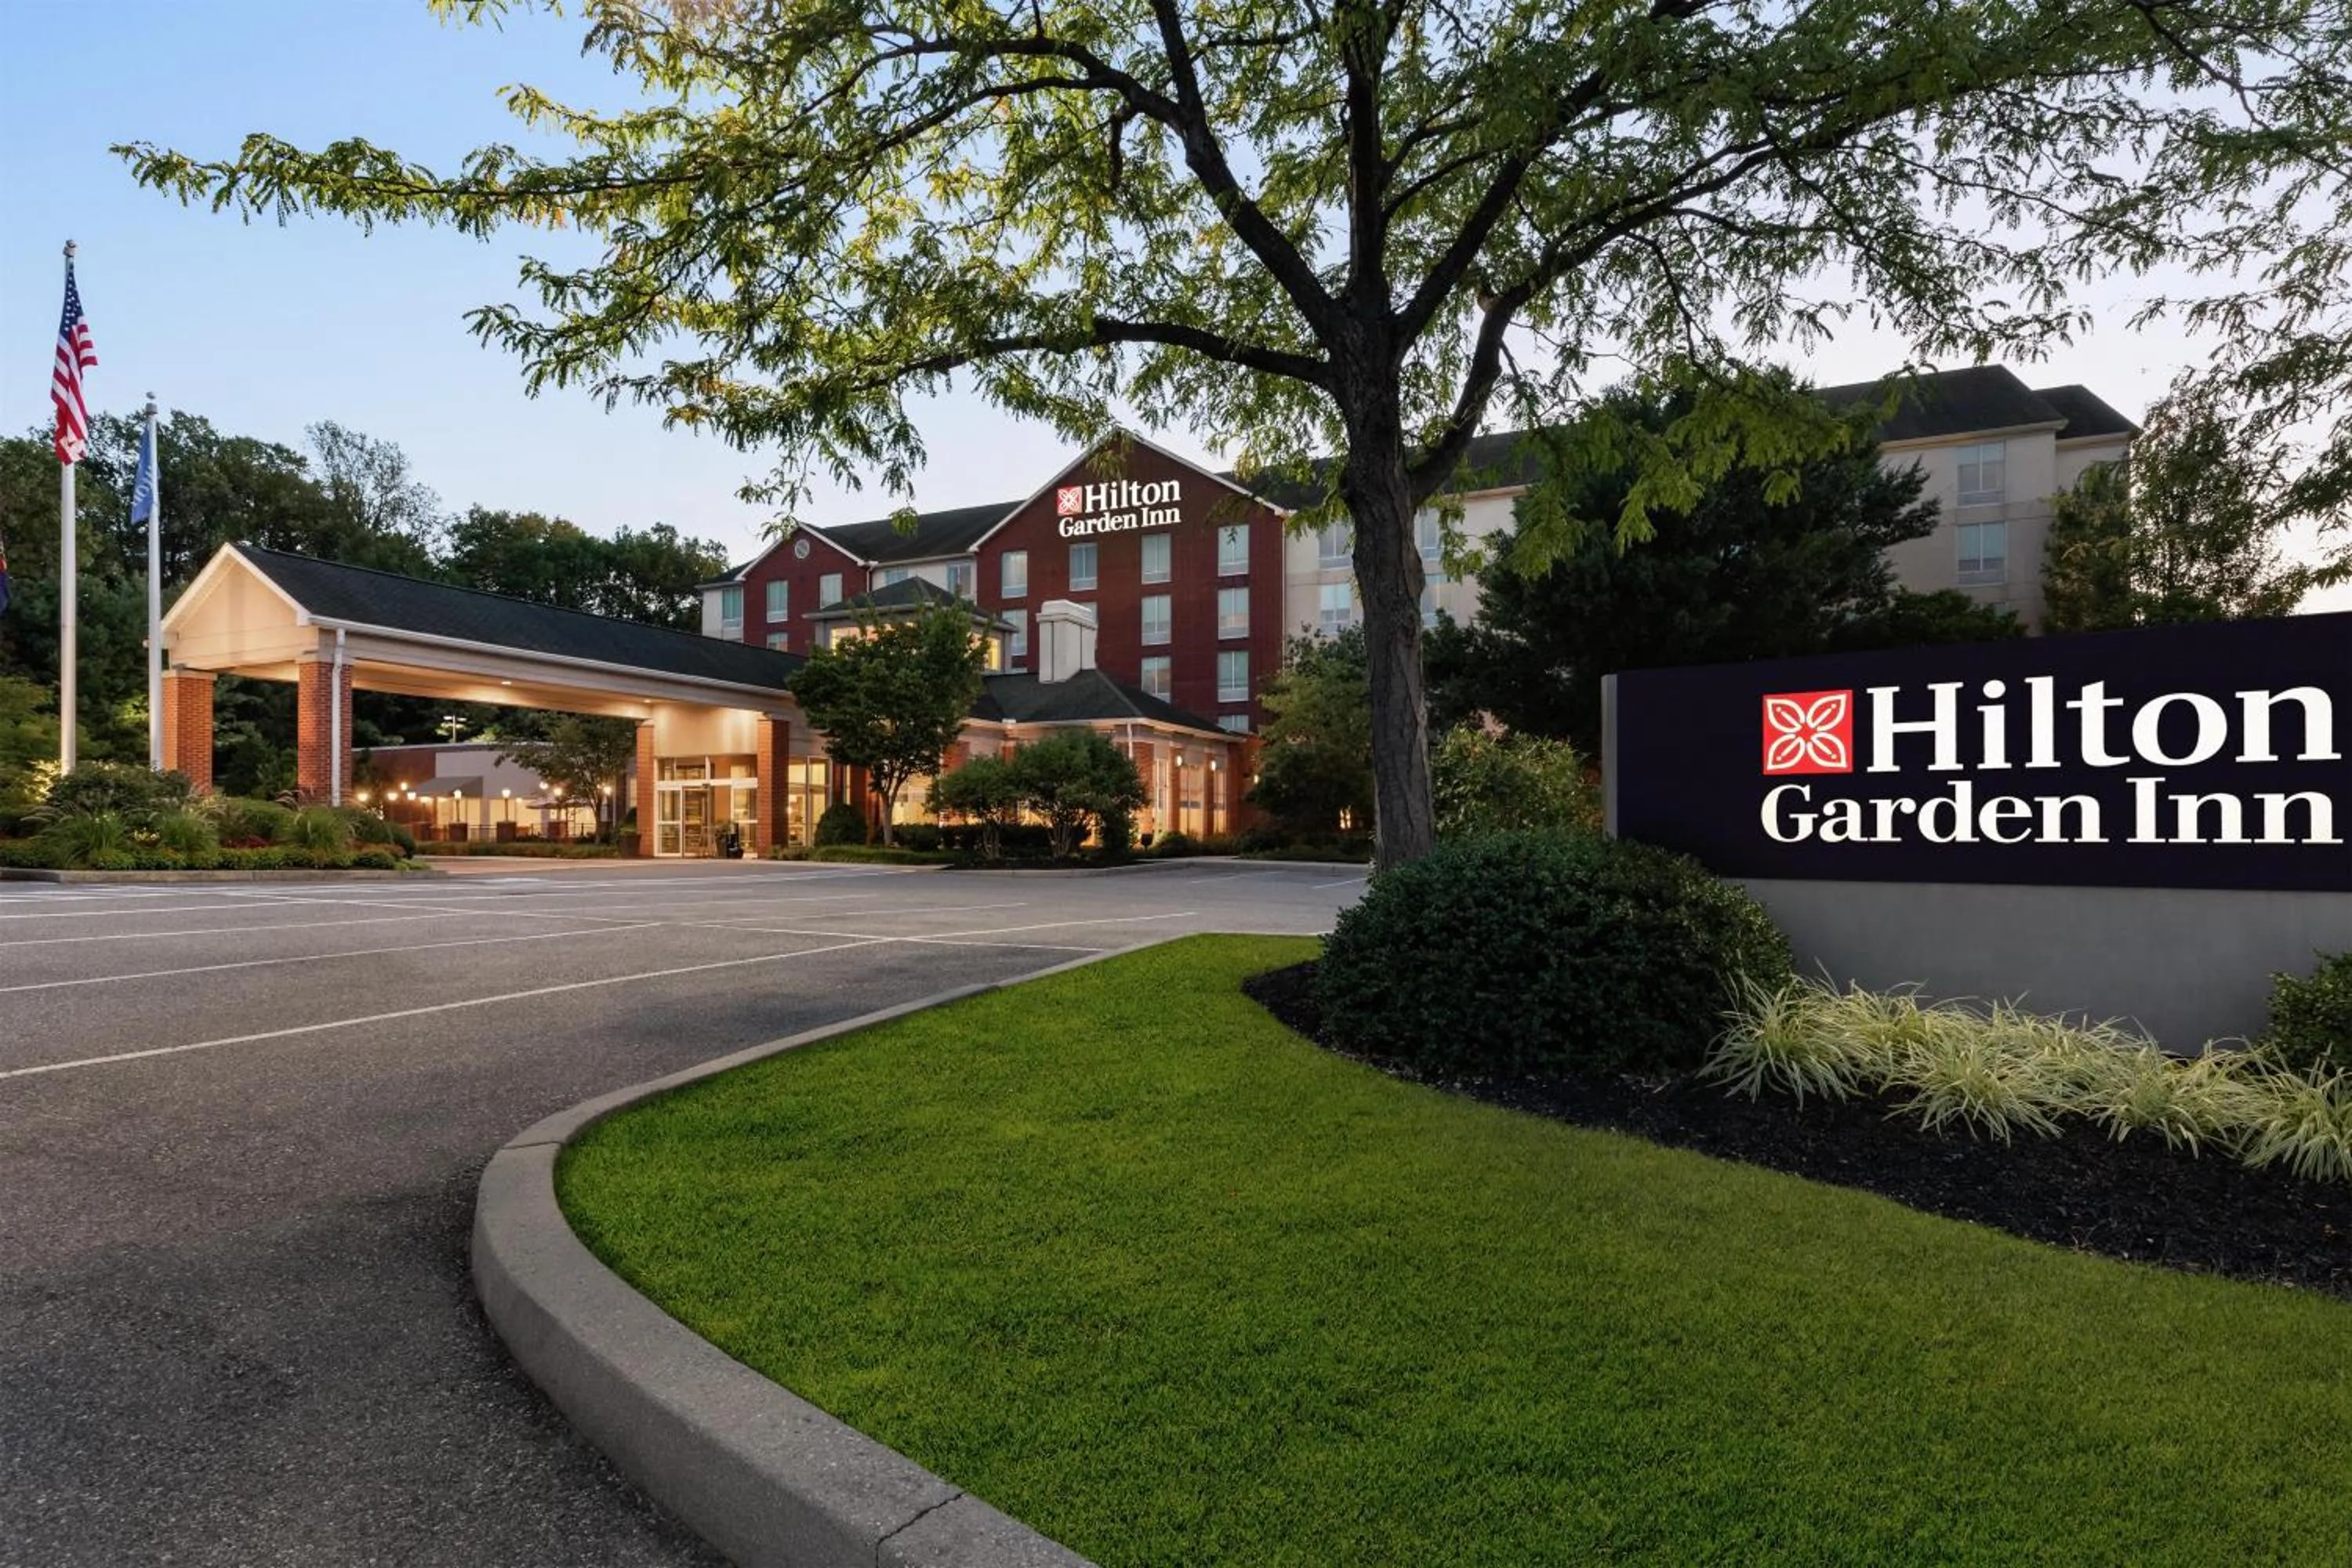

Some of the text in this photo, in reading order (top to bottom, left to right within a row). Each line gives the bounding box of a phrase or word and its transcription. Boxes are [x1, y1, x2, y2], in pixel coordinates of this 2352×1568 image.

[1059, 506, 1181, 537] Garden Inn
[1085, 479, 1181, 514] Hilton
[1866, 675, 2343, 773] Hilton
[1761, 777, 2343, 844] Garden Inn
